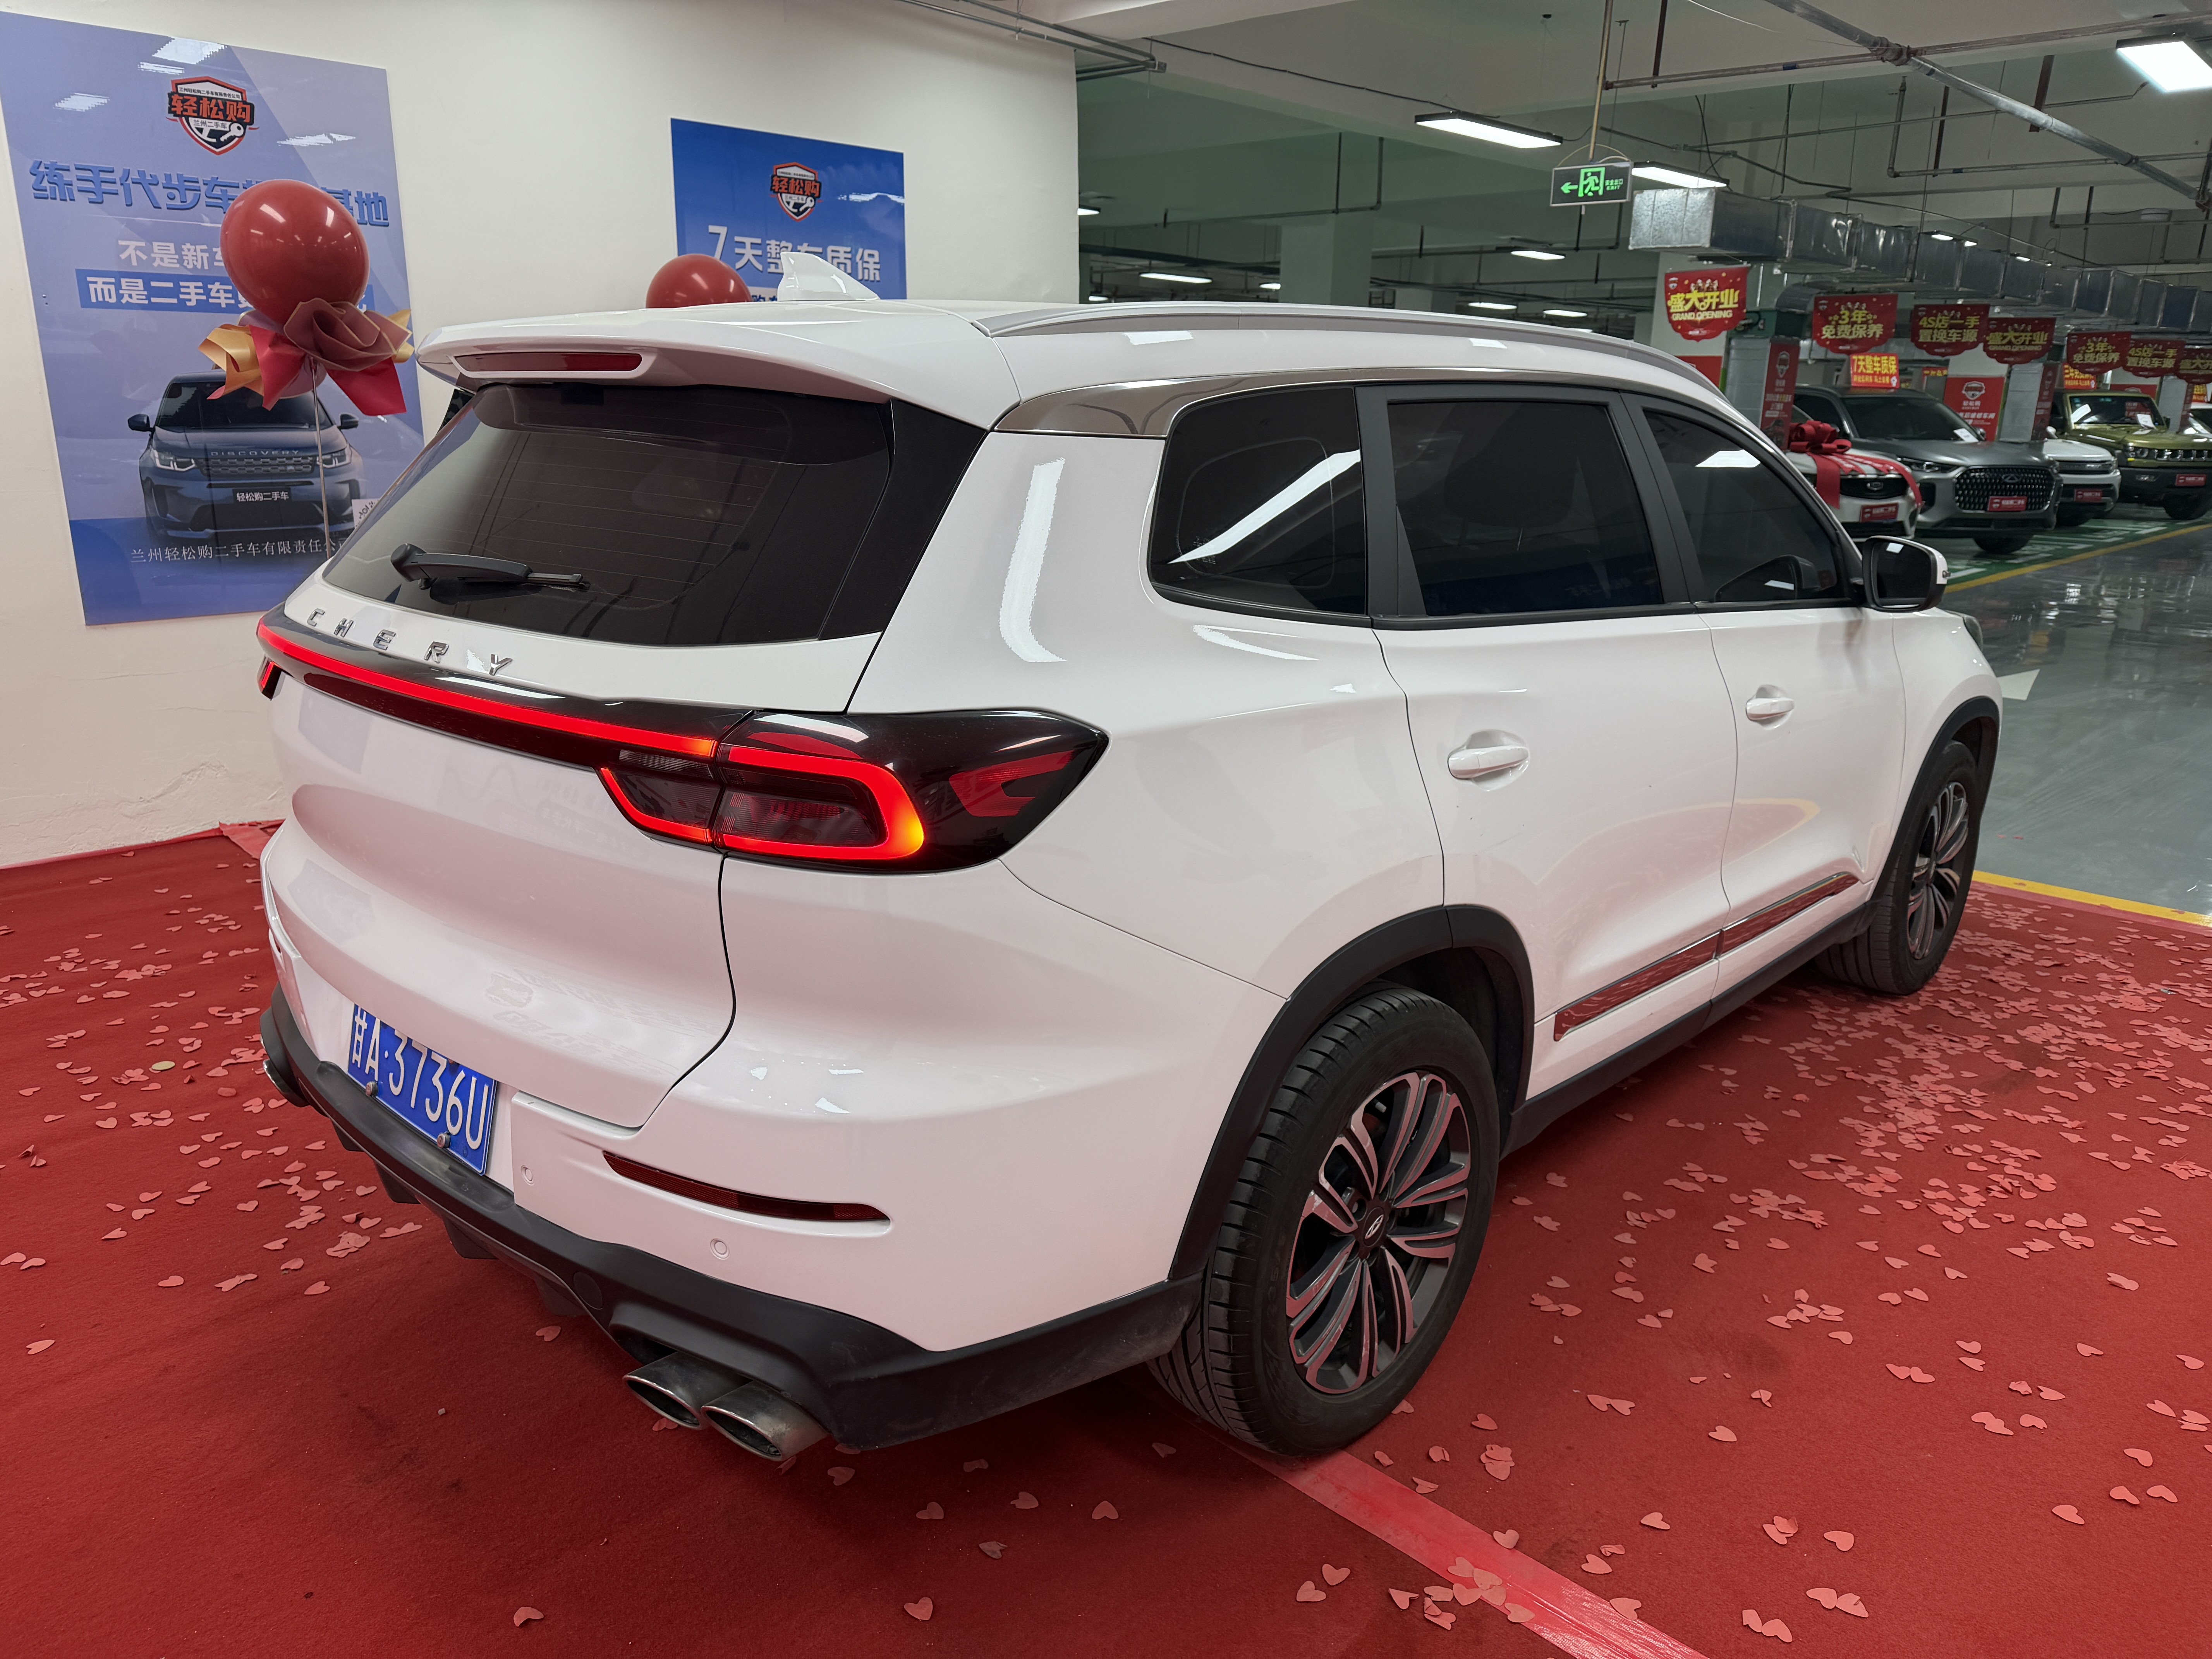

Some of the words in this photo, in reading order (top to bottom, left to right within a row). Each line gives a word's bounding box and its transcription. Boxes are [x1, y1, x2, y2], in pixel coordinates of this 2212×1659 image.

[171, 94, 251, 123] 轻松购
[193, 119, 228, 129] 兰州二手车
[29, 160, 389, 227] 练手代步车基地
[772, 176, 820, 198] 轻松购
[1668, 289, 1740, 312] 盛大开业
[1672, 311, 1695, 321] GRAND
[1697, 310, 1733, 320] OPENING
[1839, 310, 1868, 324] 3年
[1919, 316, 1980, 329] 4S店一手
[1821, 324, 1884, 339] 免费保养
[1918, 329, 1978, 342] 置换车源
[1986, 331, 2049, 345] 盛大开业
[1853, 355, 1897, 374] 7天整车质保
[236, 491, 289, 502] 轻松购二手车
[306, 608, 514, 676] CHERY
